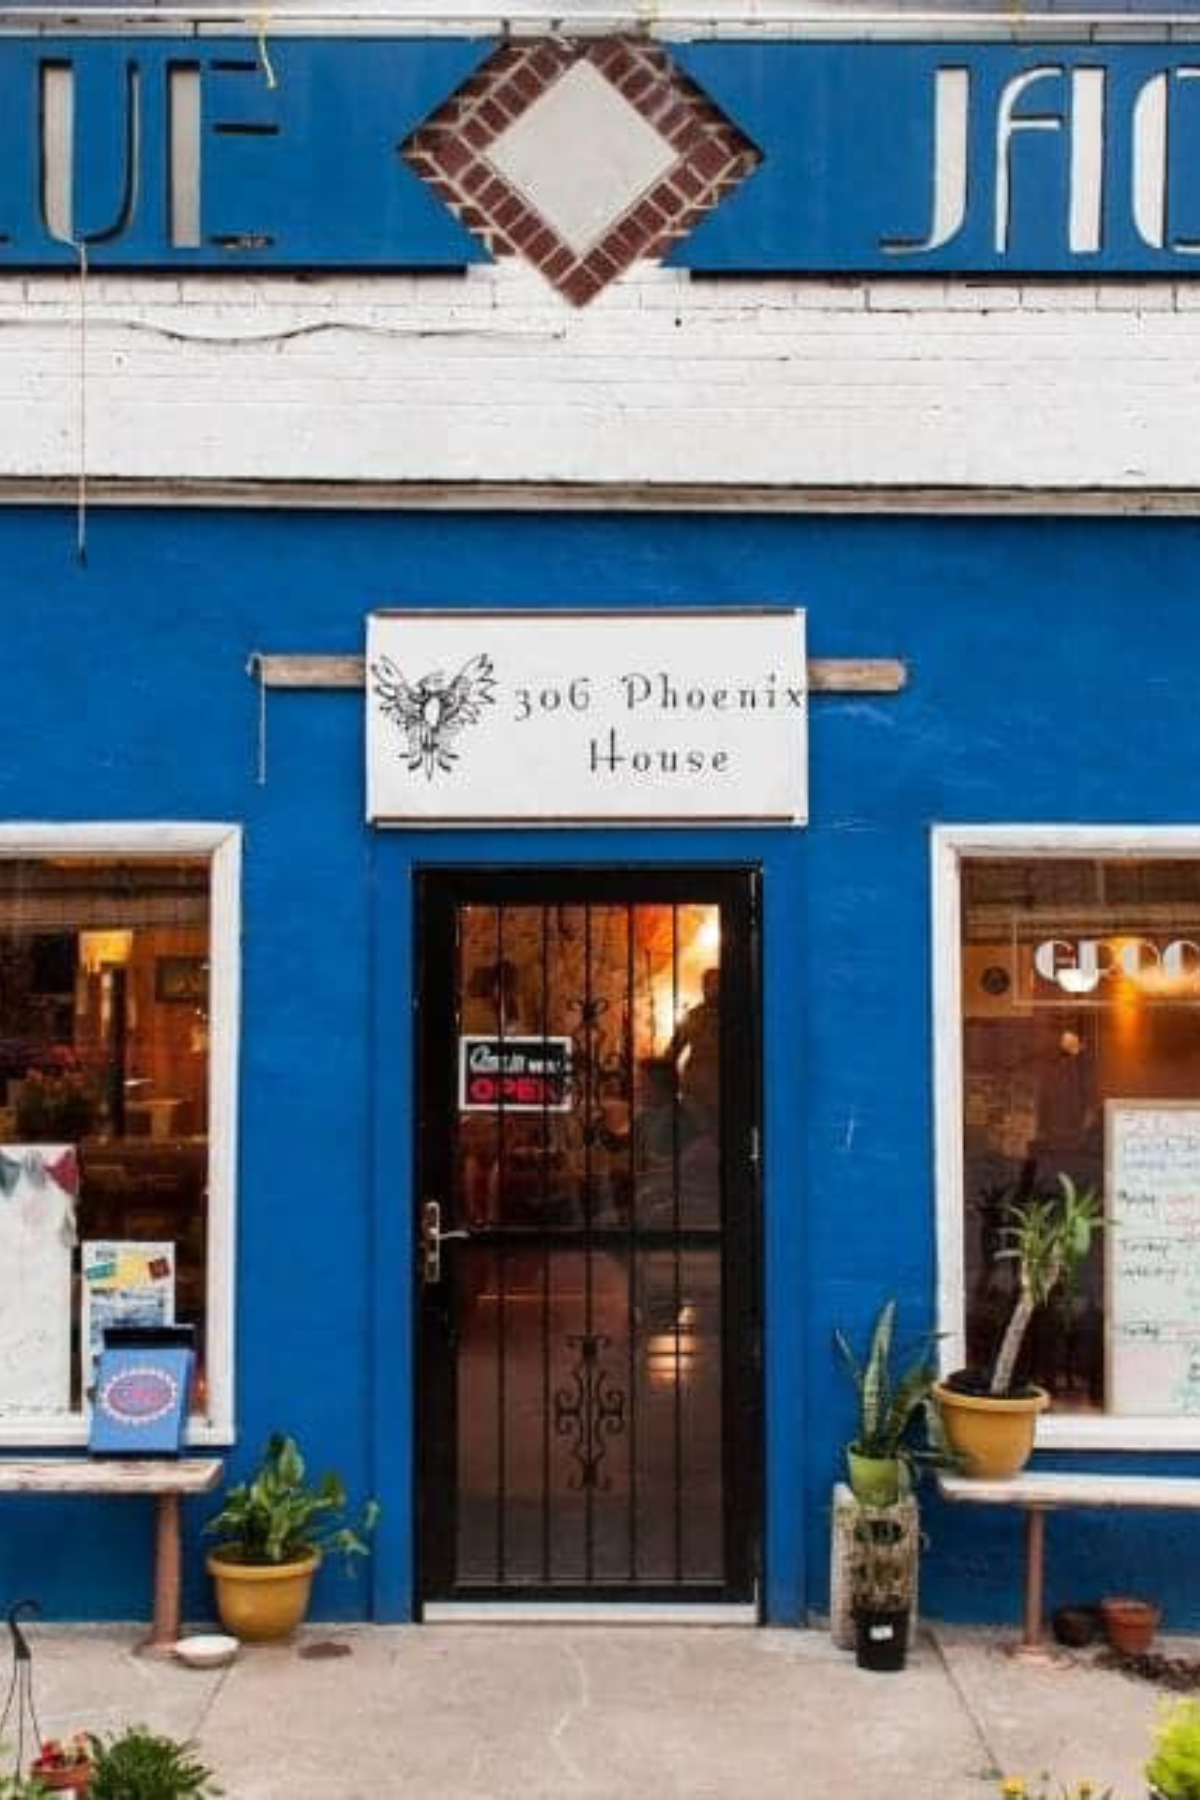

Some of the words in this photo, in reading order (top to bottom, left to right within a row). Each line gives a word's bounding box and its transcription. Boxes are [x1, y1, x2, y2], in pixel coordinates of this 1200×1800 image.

[0, 59, 279, 249] UE
[513, 677, 592, 721] 306
[620, 672, 807, 711] Phoenix
[589, 727, 729, 773] House
